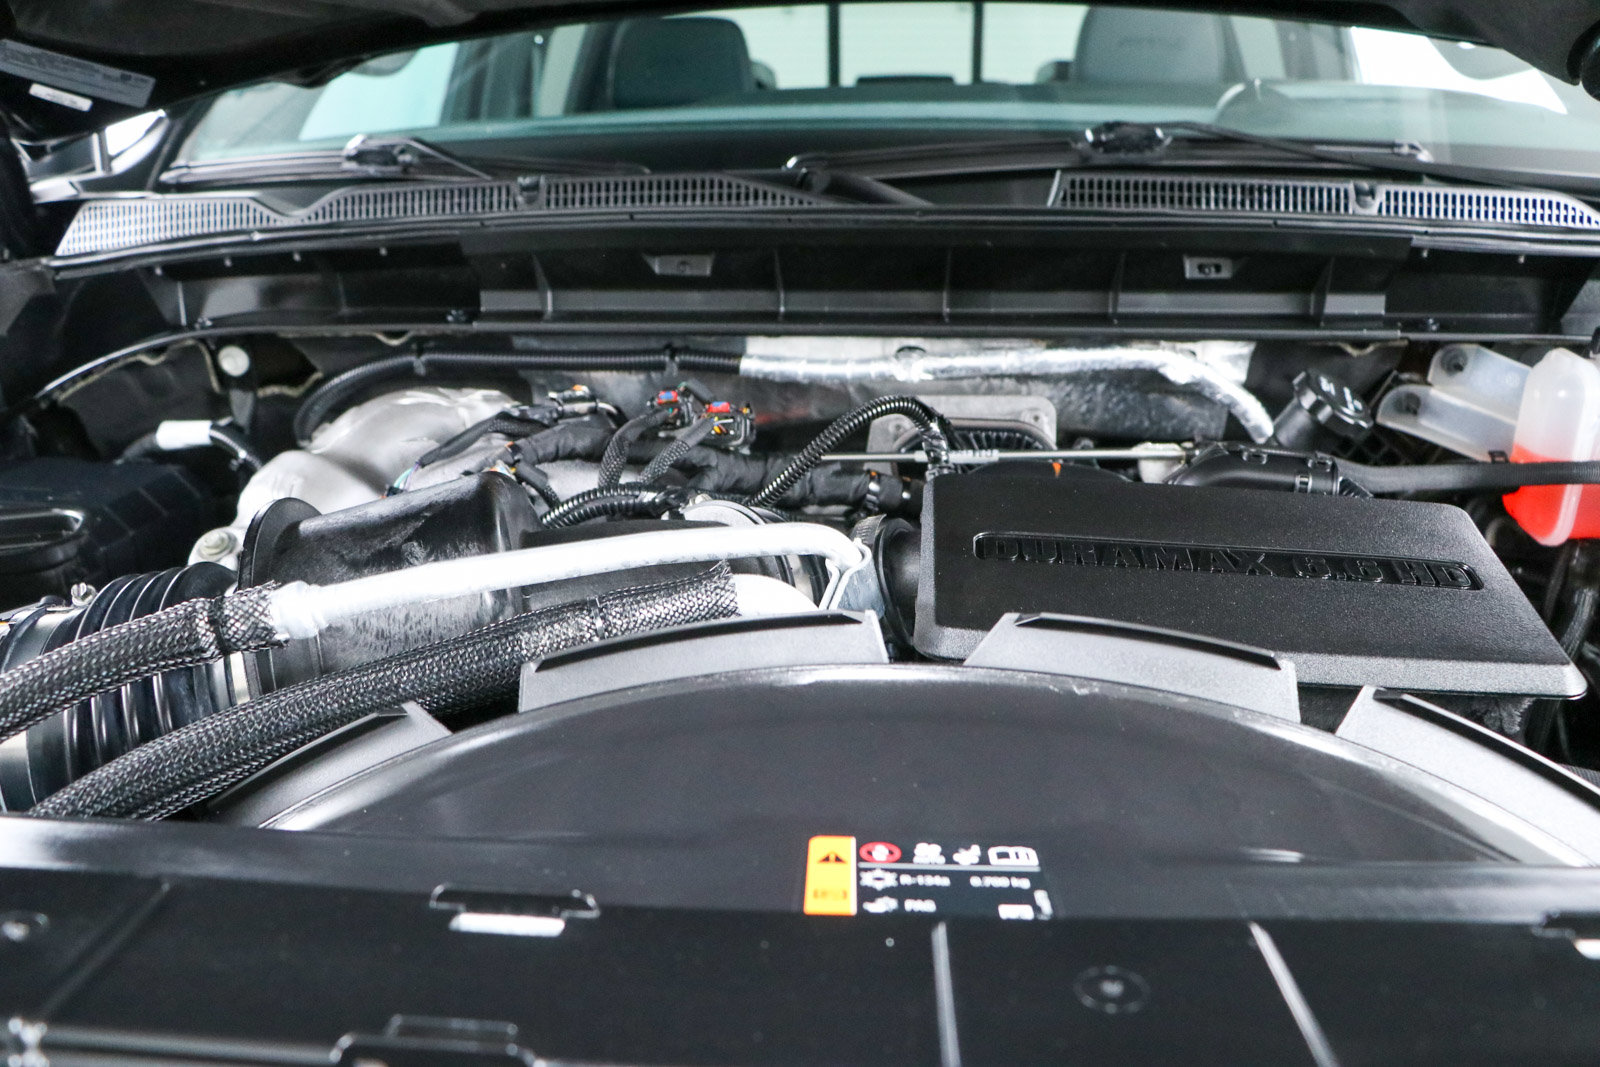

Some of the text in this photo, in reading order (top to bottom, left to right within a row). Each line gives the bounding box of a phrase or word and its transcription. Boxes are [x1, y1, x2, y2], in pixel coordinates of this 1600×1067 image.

[983, 537, 1473, 589] DURAMAX 6.6 HD
